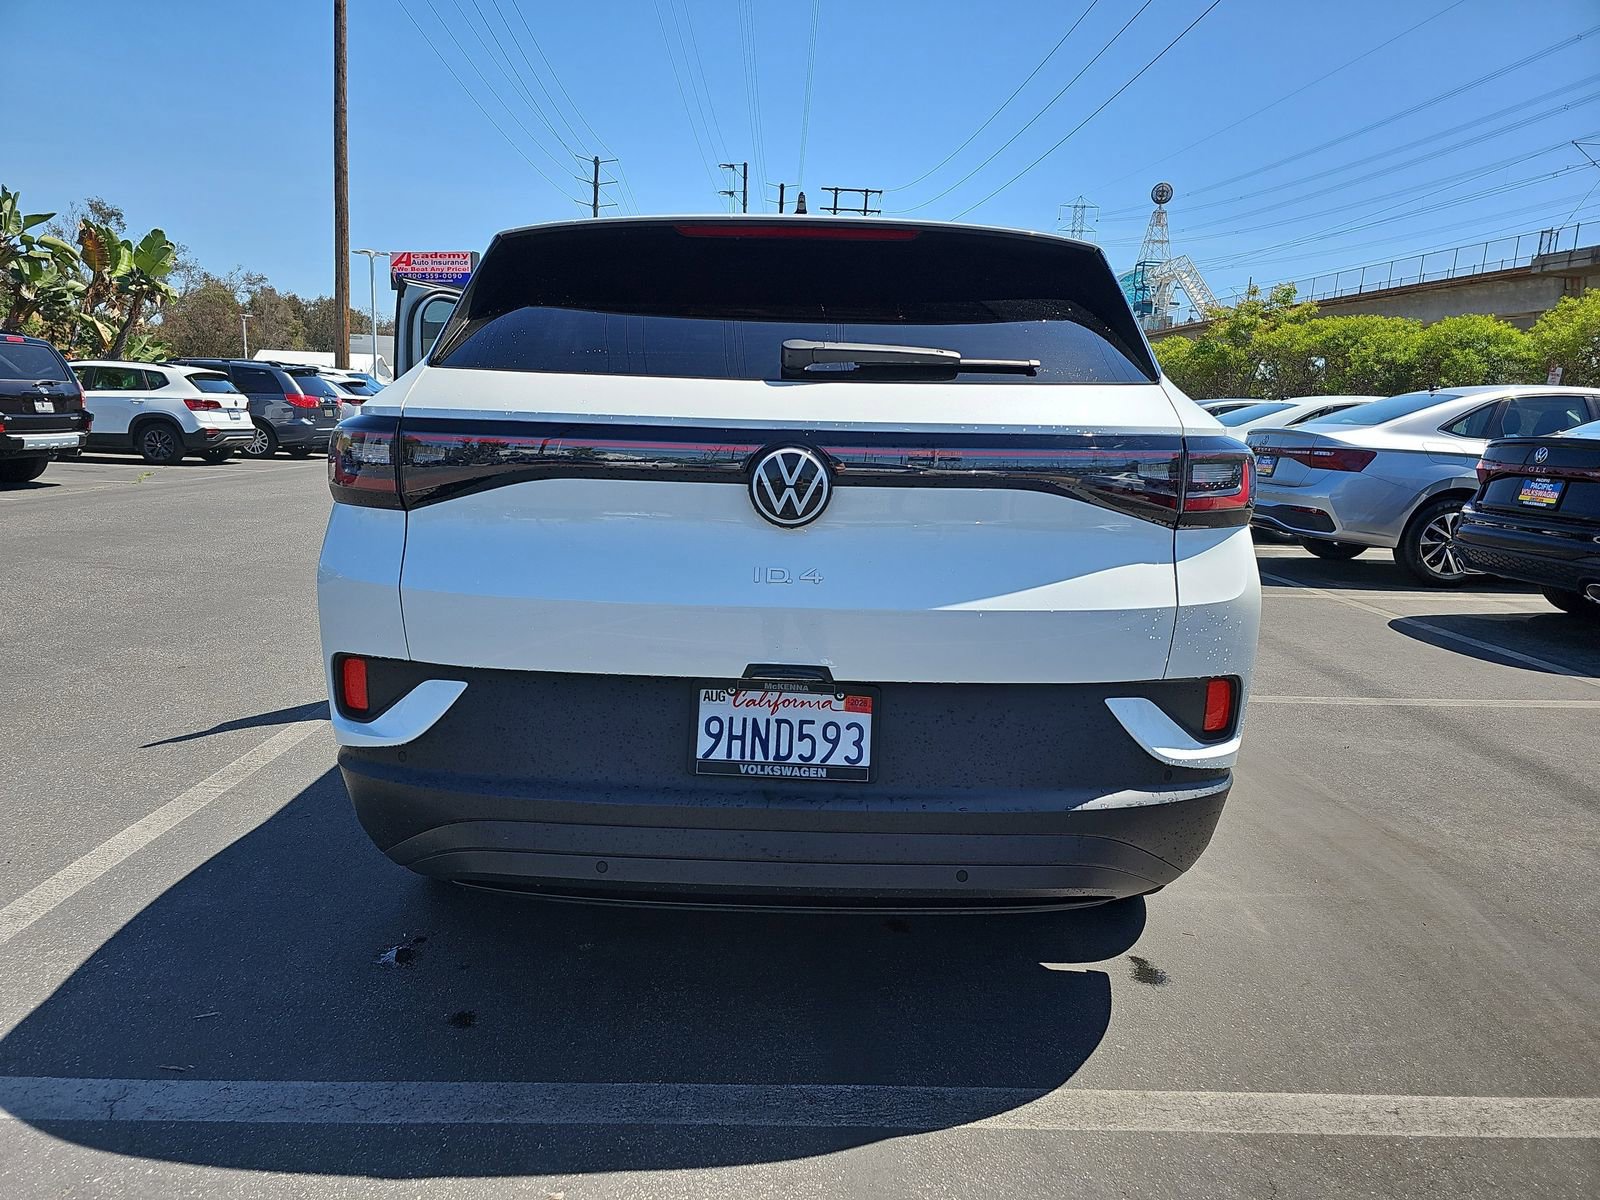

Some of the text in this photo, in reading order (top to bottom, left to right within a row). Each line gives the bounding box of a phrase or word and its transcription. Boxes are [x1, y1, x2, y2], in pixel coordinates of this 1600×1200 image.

[391, 252, 469, 266] Academy
[1530, 482, 1554, 491] PACIFIC
[1521, 488, 1560, 499] VOLKSWAGEN
[764, 682, 809, 692] McKENNA
[703, 690, 727, 703] AUG
[732, 690, 846, 716] California
[702, 715, 865, 765] 9HND593
[739, 764, 827, 778] VOLKSWAGEN
